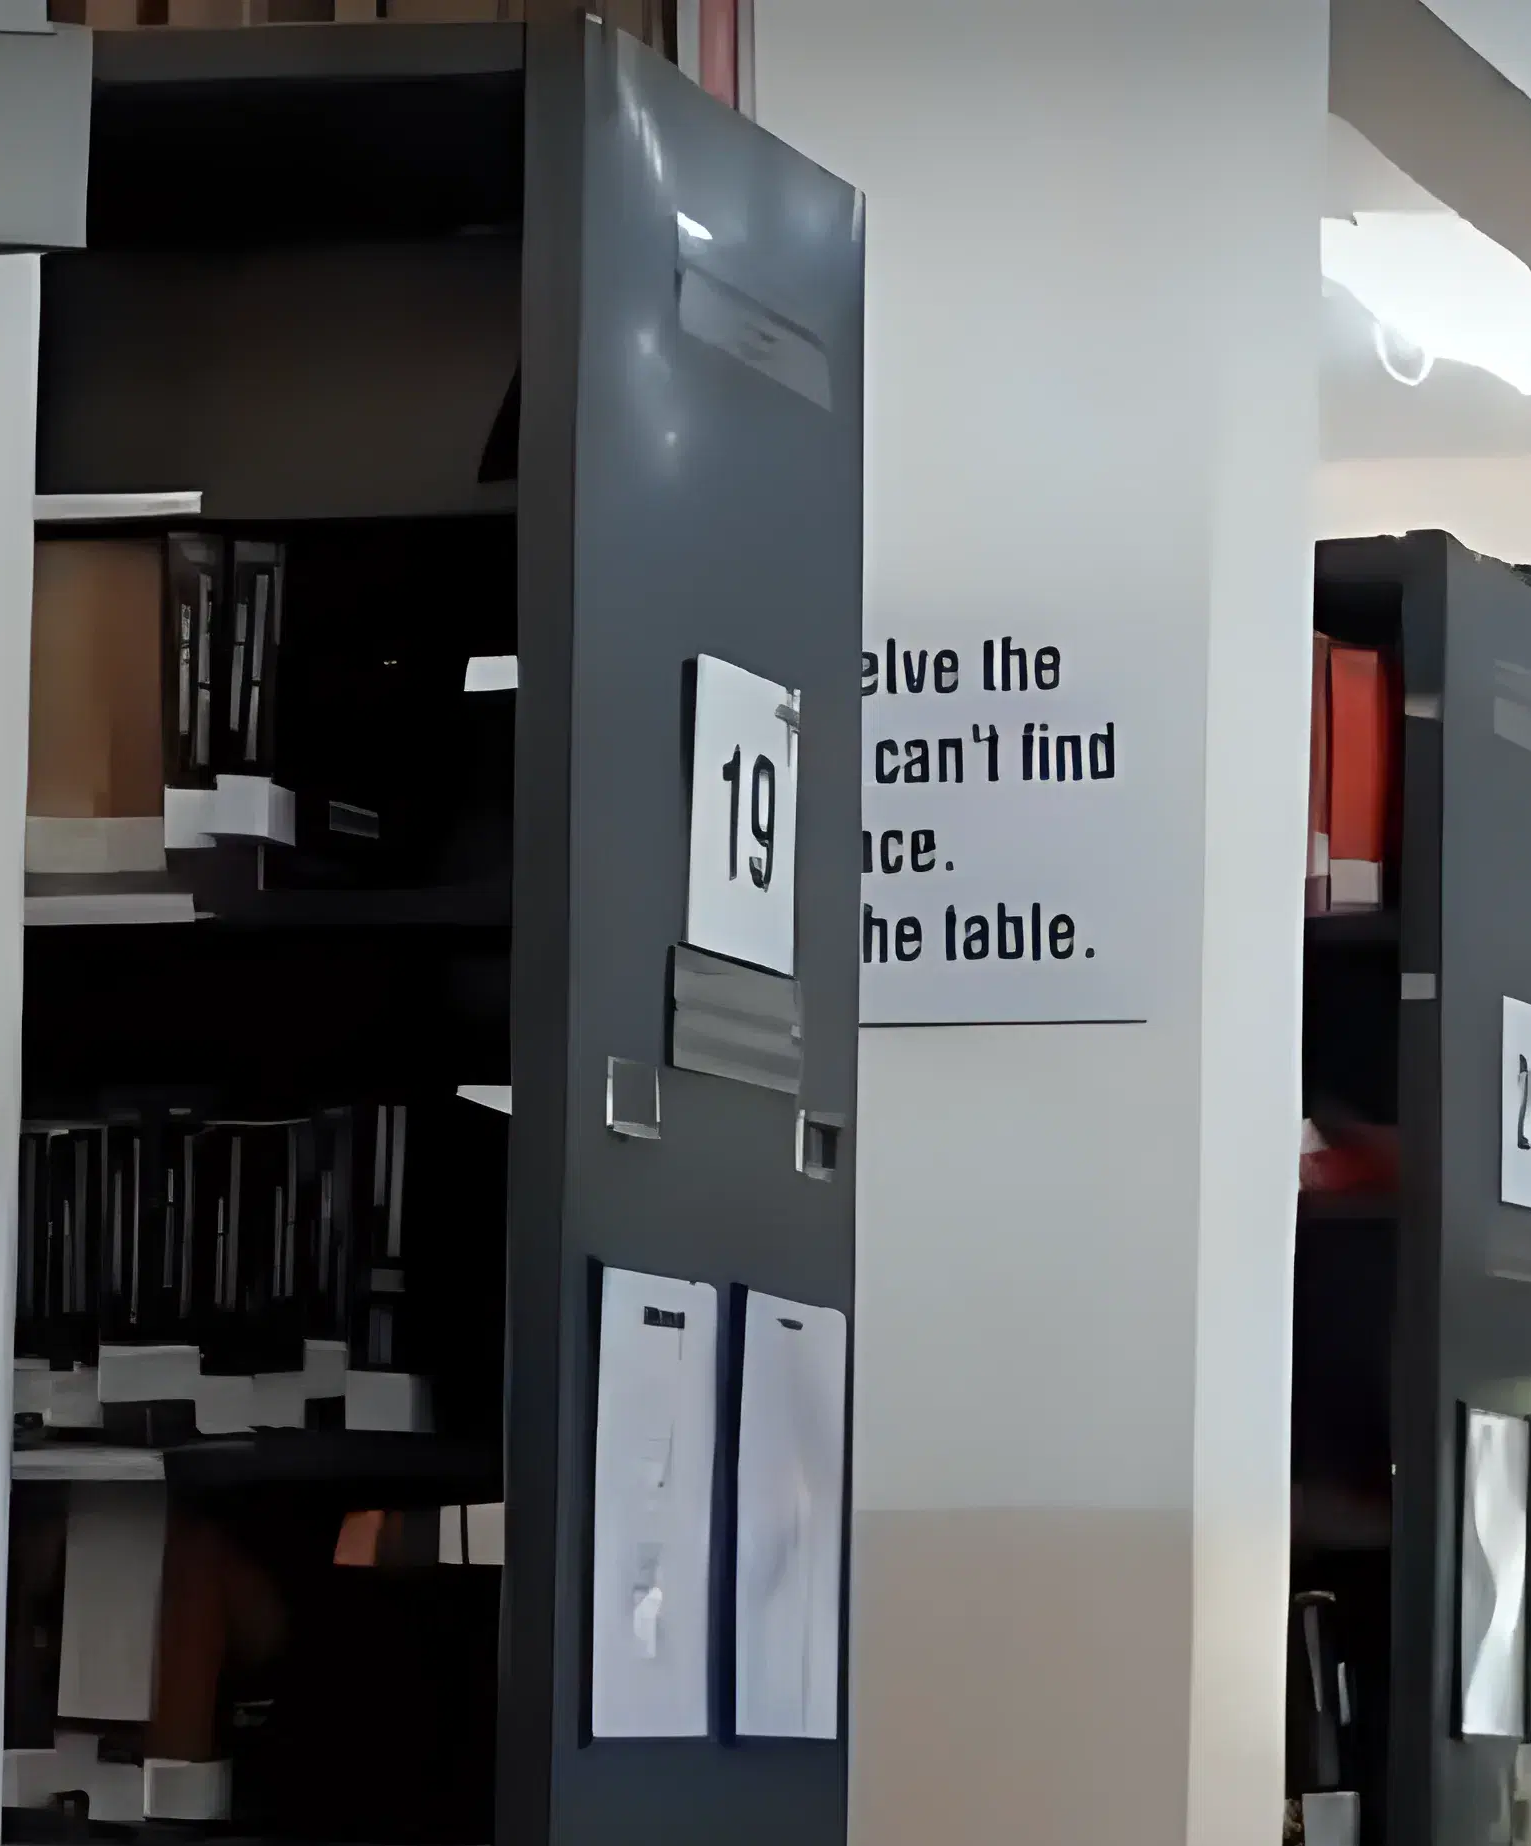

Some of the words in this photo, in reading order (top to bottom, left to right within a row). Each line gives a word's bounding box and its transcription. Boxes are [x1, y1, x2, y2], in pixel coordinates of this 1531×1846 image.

[983, 635, 1061, 692] the
[875, 723, 1000, 784] can't
[1021, 722, 1116, 782] find
[722, 744, 775, 893] 19
[945, 901, 1096, 962] table.
